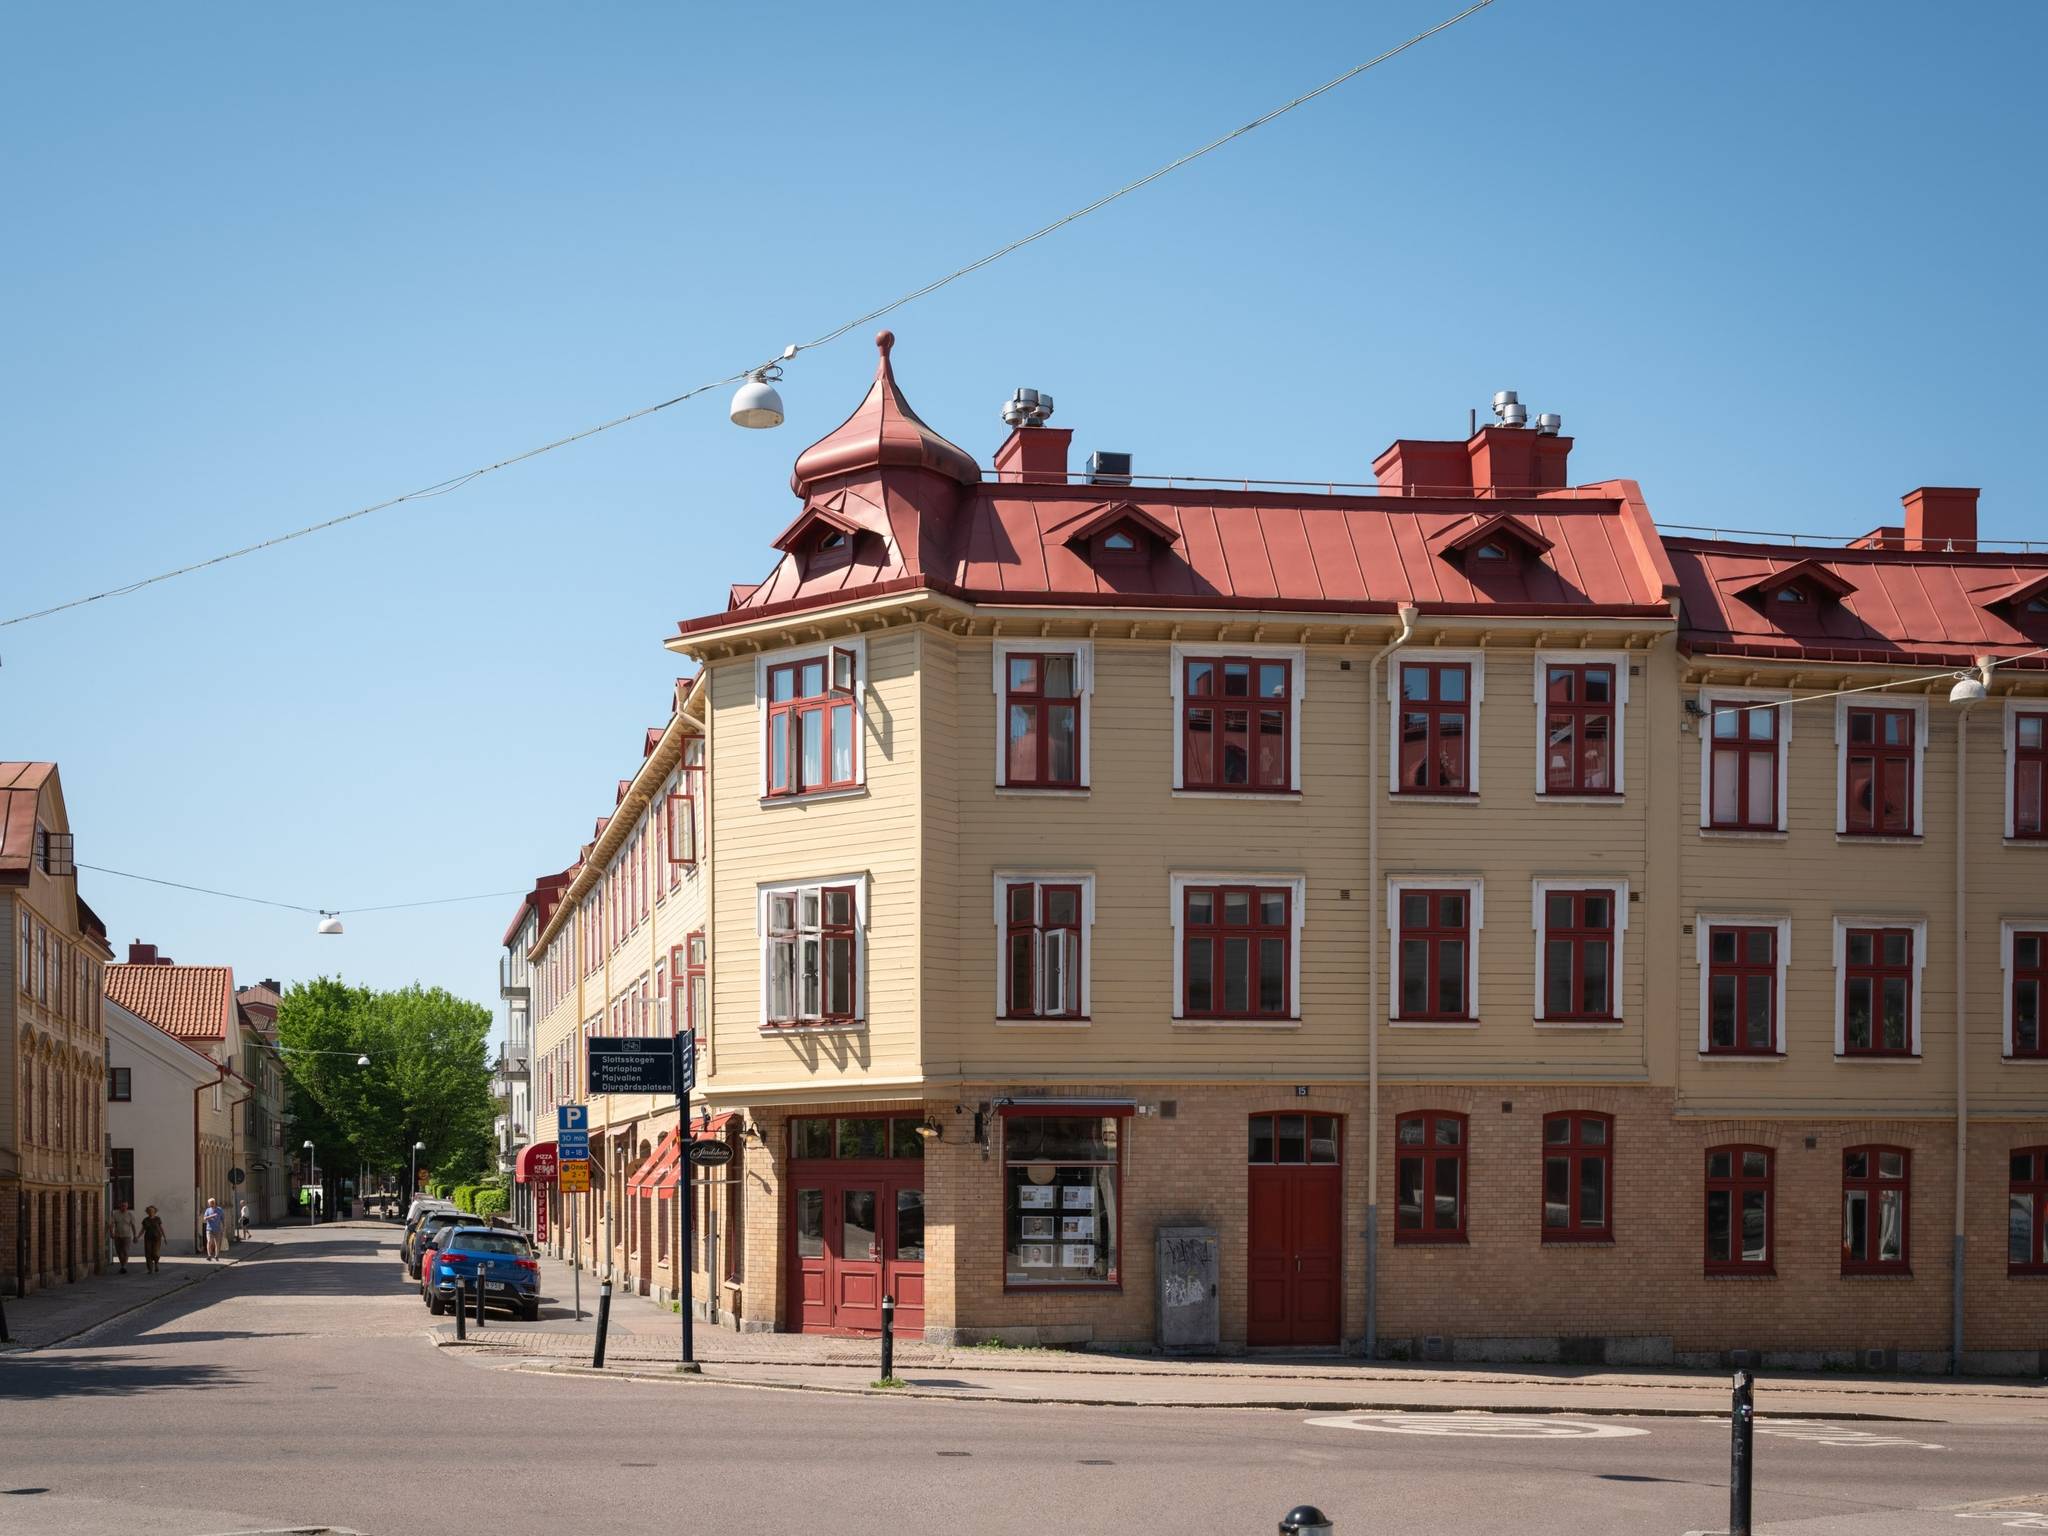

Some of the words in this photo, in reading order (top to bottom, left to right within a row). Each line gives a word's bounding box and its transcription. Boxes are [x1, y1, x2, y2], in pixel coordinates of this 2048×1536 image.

[602, 1055, 655, 1065] Slottsskogen
[602, 1065, 642, 1074] Mariaplan
[602, 1074, 641, 1083] Majvallen
[602, 1083, 672, 1092] Djurgårdsplatsen
[566, 1107, 582, 1129] P
[573, 1134, 586, 1142] min
